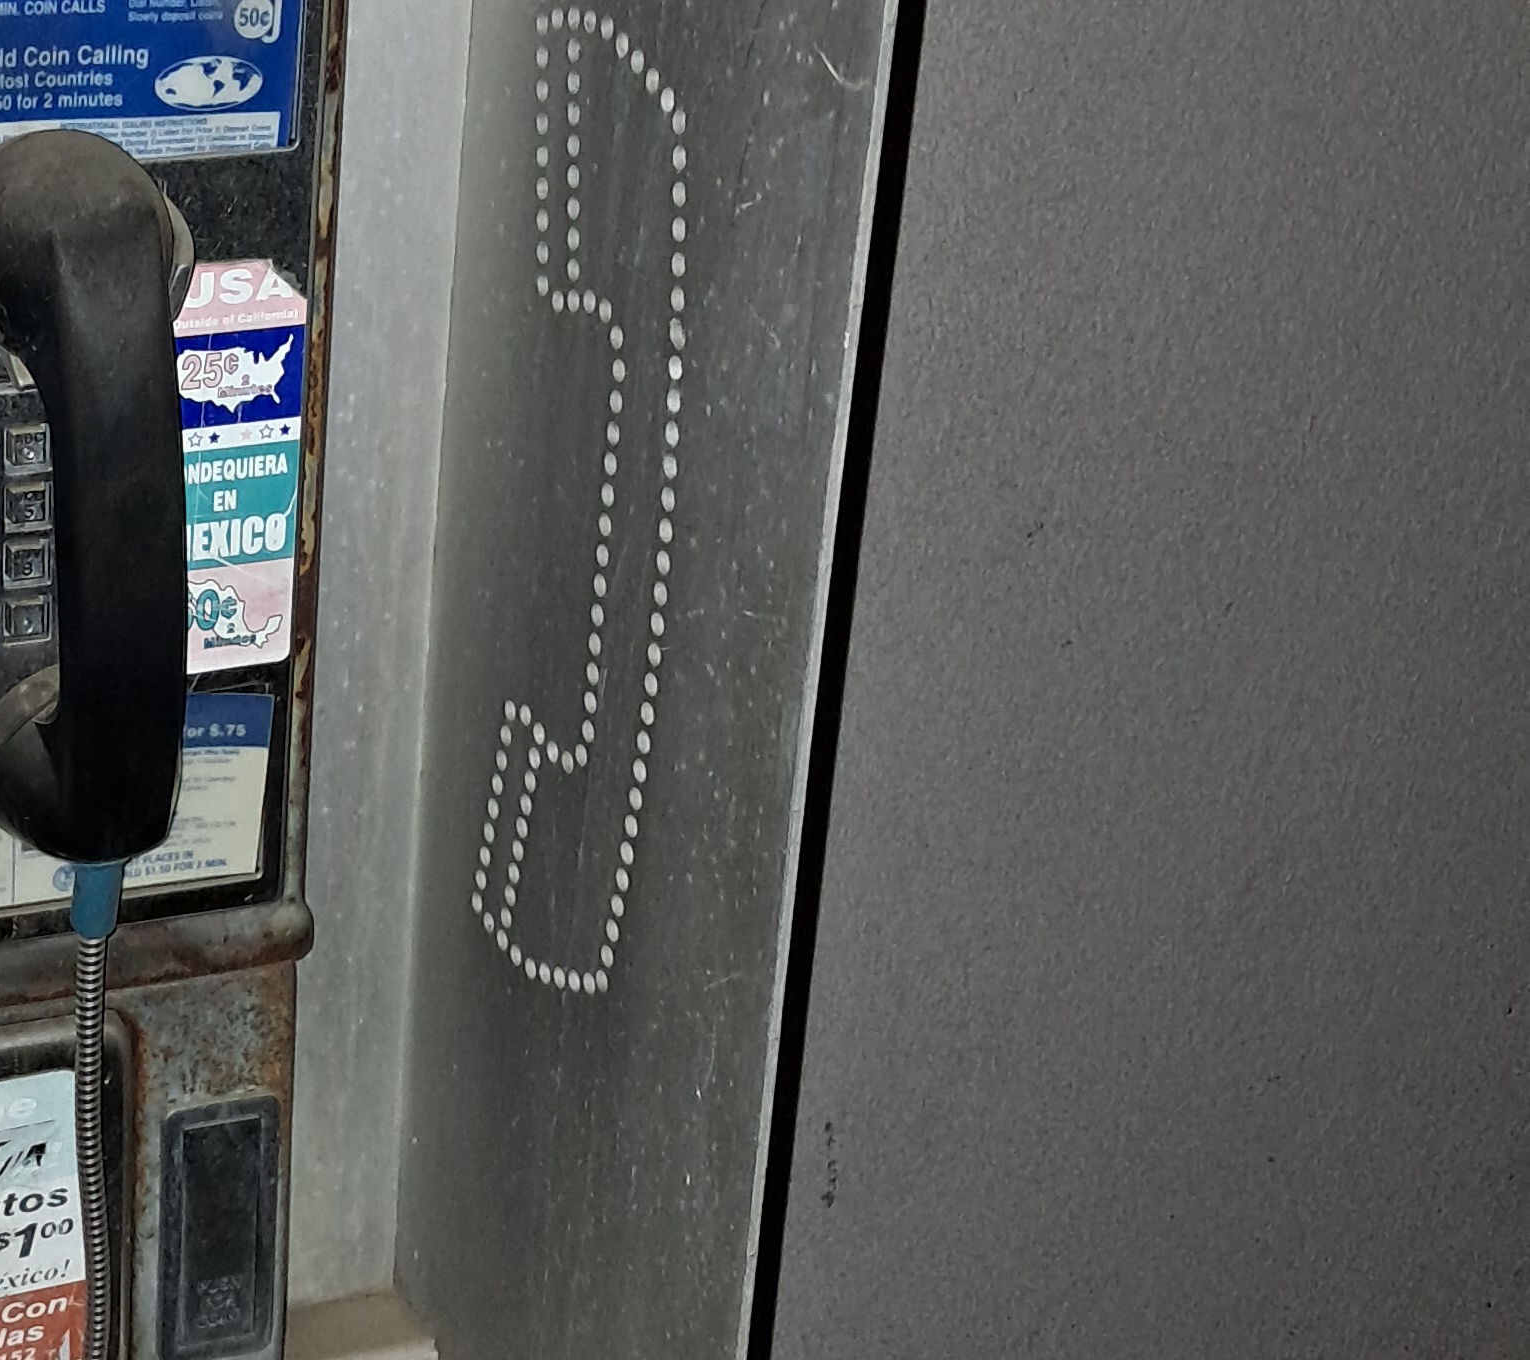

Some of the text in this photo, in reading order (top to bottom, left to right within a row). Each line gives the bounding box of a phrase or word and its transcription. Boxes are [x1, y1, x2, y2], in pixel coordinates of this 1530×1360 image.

[24, 0, 58, 16] COIN
[23, 45, 70, 68] Coin
[77, 44, 150, 70] Calling
[34, 70, 113, 89] Countries
[17, 93, 38, 111] for
[43, 92, 53, 109] 2
[58, 92, 123, 109] minutes
[184, 267, 294, 309] USA
[184, 452, 288, 485] NDEQUIERA
[213, 488, 237, 513] EN
[186, 512, 287, 558] EXICO
[1, 1296, 68, 1324] Con
